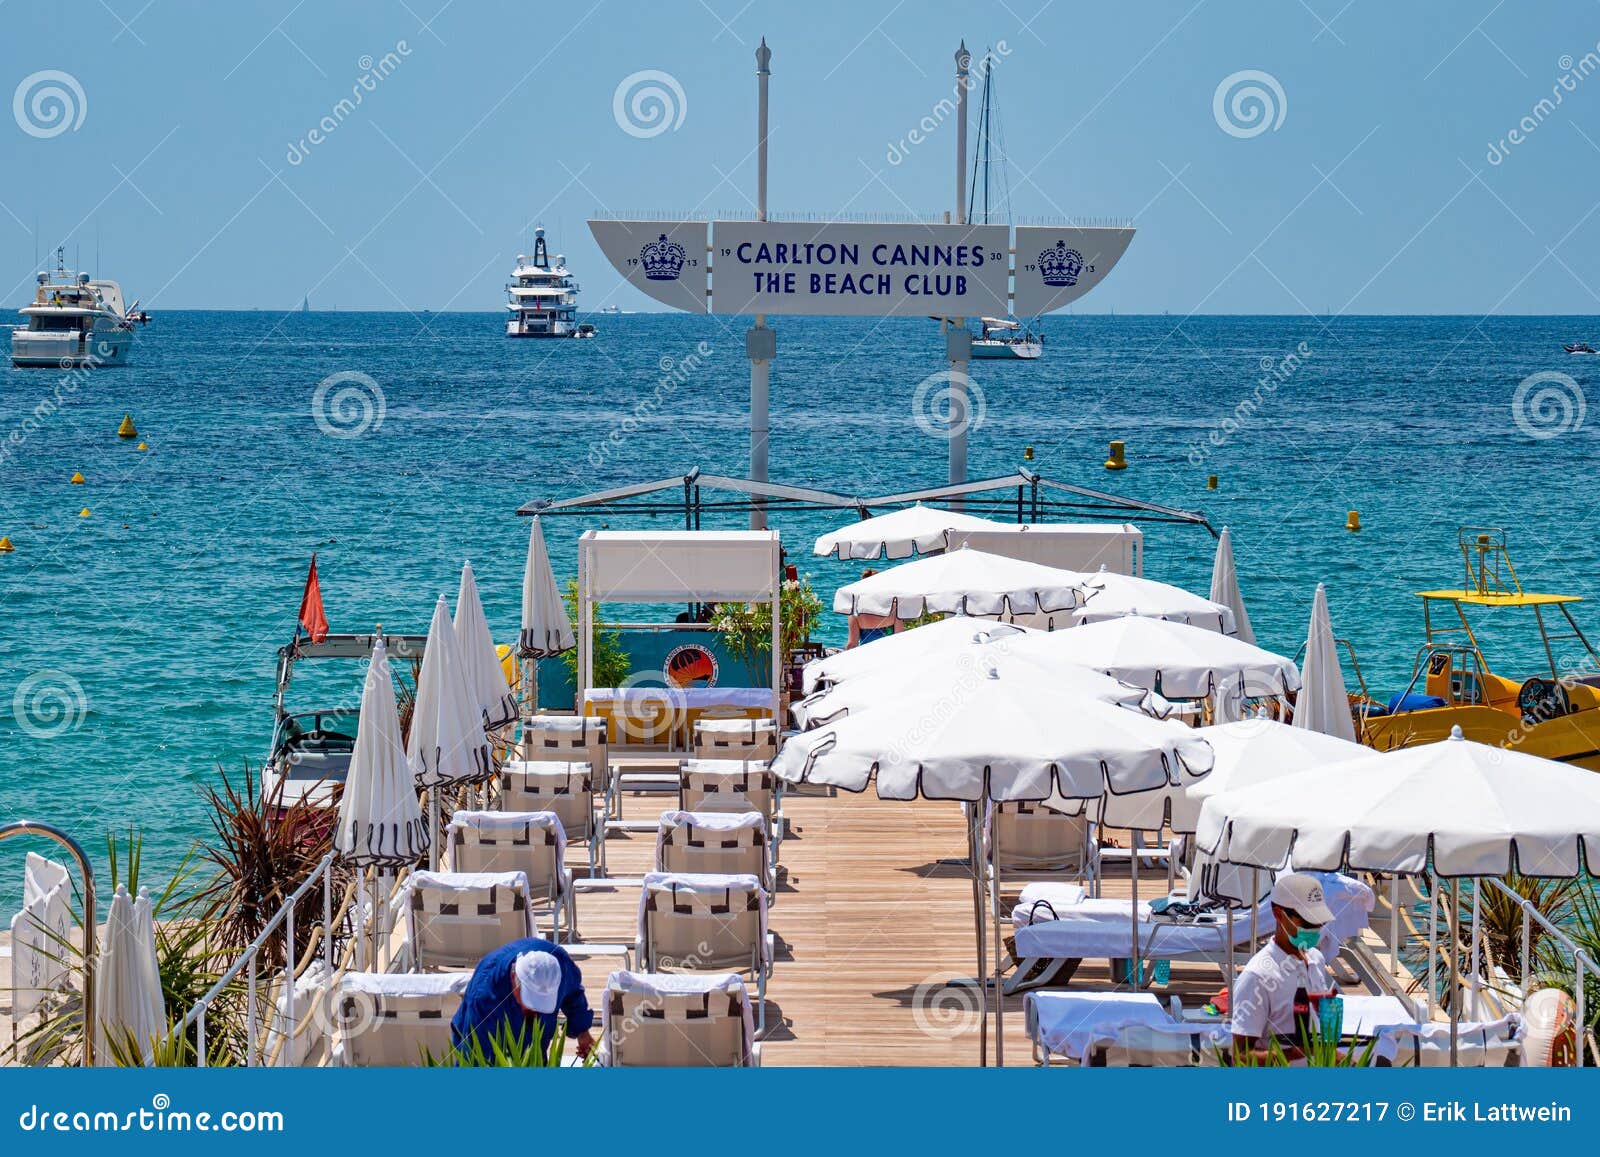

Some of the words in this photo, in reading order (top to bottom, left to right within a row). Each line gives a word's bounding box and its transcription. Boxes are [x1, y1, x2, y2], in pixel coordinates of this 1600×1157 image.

[720, 248, 732, 257] 19
[737, 243, 858, 265] CARLTON
[872, 244, 984, 267] CANNES
[989, 252, 1002, 261] 30
[627, 258, 639, 267] 19
[686, 259, 698, 267] 13
[1023, 264, 1036, 273] 19
[1084, 264, 1096, 273] 13
[754, 272, 795, 293] THE
[810, 273, 890, 295] BEACH
[904, 274, 966, 296] CLUB
